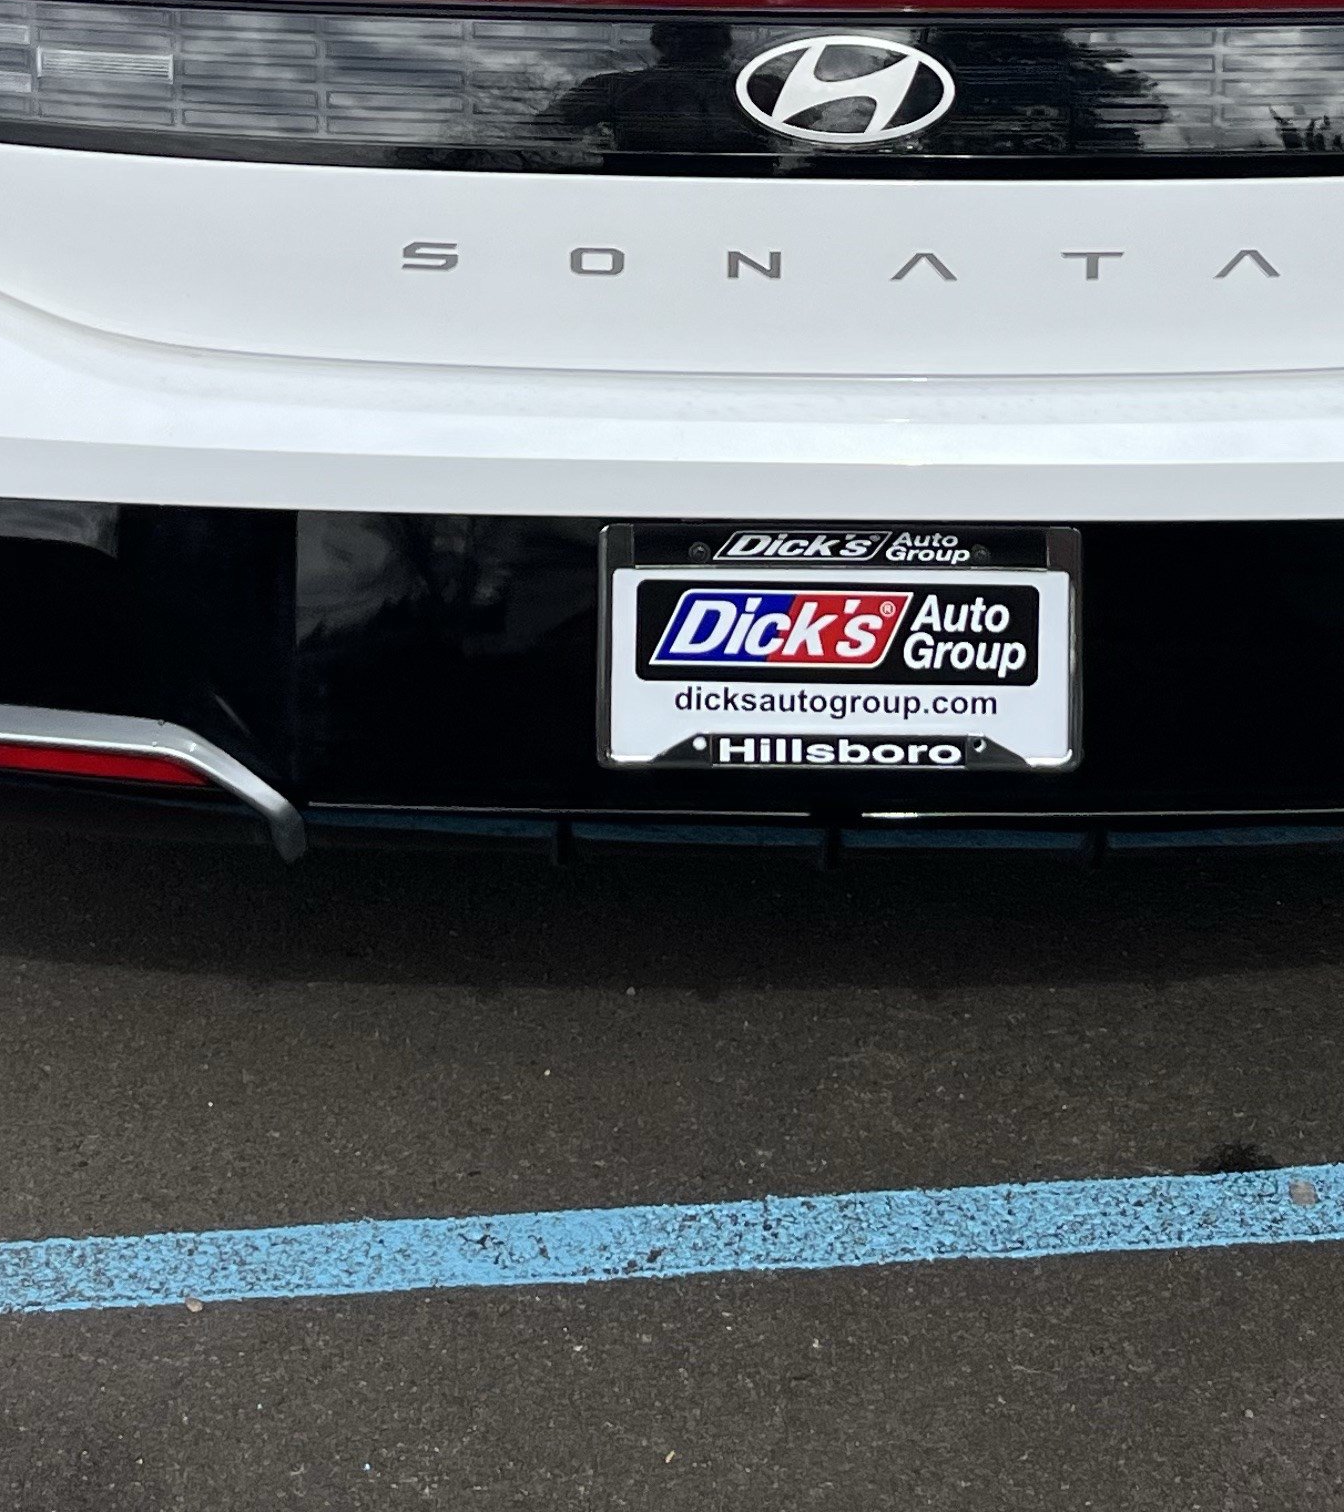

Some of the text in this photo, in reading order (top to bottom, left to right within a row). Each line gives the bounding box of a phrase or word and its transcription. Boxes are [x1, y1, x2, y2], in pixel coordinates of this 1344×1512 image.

[401, 241, 1281, 281] SONATA
[885, 546, 971, 564] Group
[892, 532, 958, 548] Auto
[910, 594, 1010, 634] Auto
[903, 632, 1027, 678] Group
[674, 686, 998, 719] dicksautogroup.com
[718, 737, 962, 765] Hillsboro
